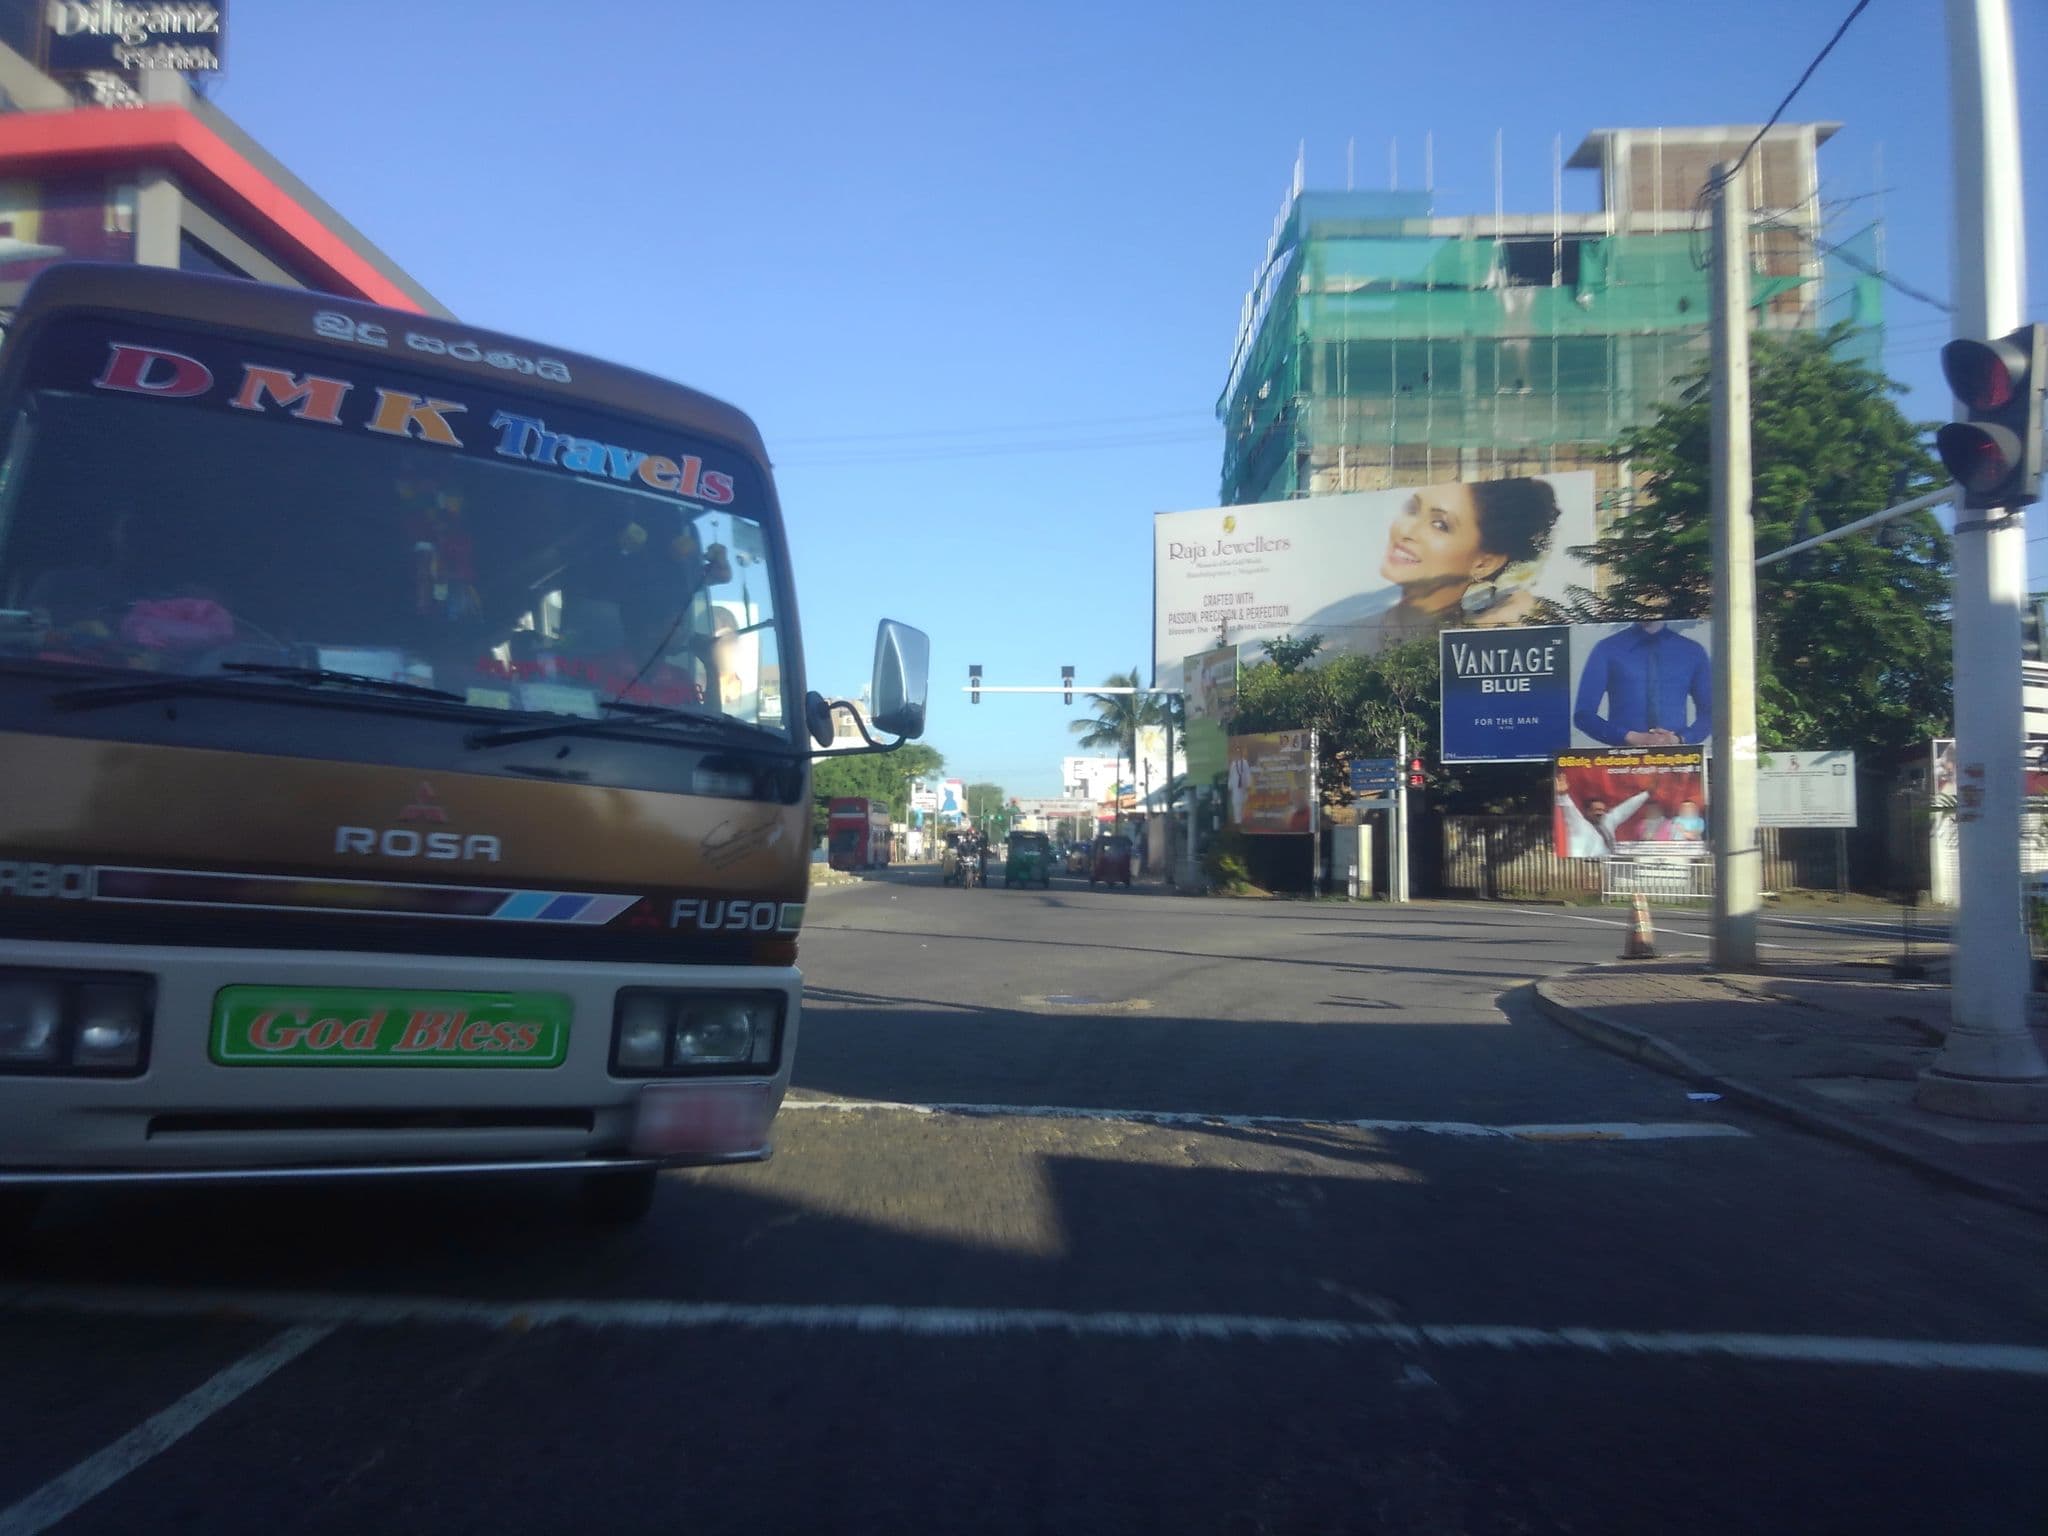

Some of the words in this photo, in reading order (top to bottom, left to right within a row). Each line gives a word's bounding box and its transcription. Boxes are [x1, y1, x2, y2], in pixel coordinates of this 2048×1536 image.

[114, 44, 219, 70] Fashion
[489, 409, 735, 504] Travels
[1168, 541, 1207, 564] Raja
[1212, 536, 1291, 556] Jewellers
[1203, 593, 1234, 607] CRAFTED
[1236, 592, 1254, 604] WITH
[1246, 605, 1289, 619] PERFECTION
[1451, 643, 1554, 675] VANTAGE
[1481, 678, 1531, 693] BLUE
[1474, 718, 1493, 726] FOR
[1496, 717, 1513, 725] THE
[334, 826, 501, 861] ROSA
[670, 898, 777, 931] FUSO
[249, 1005, 387, 1052] God
[391, 1011, 542, 1051] Bless
